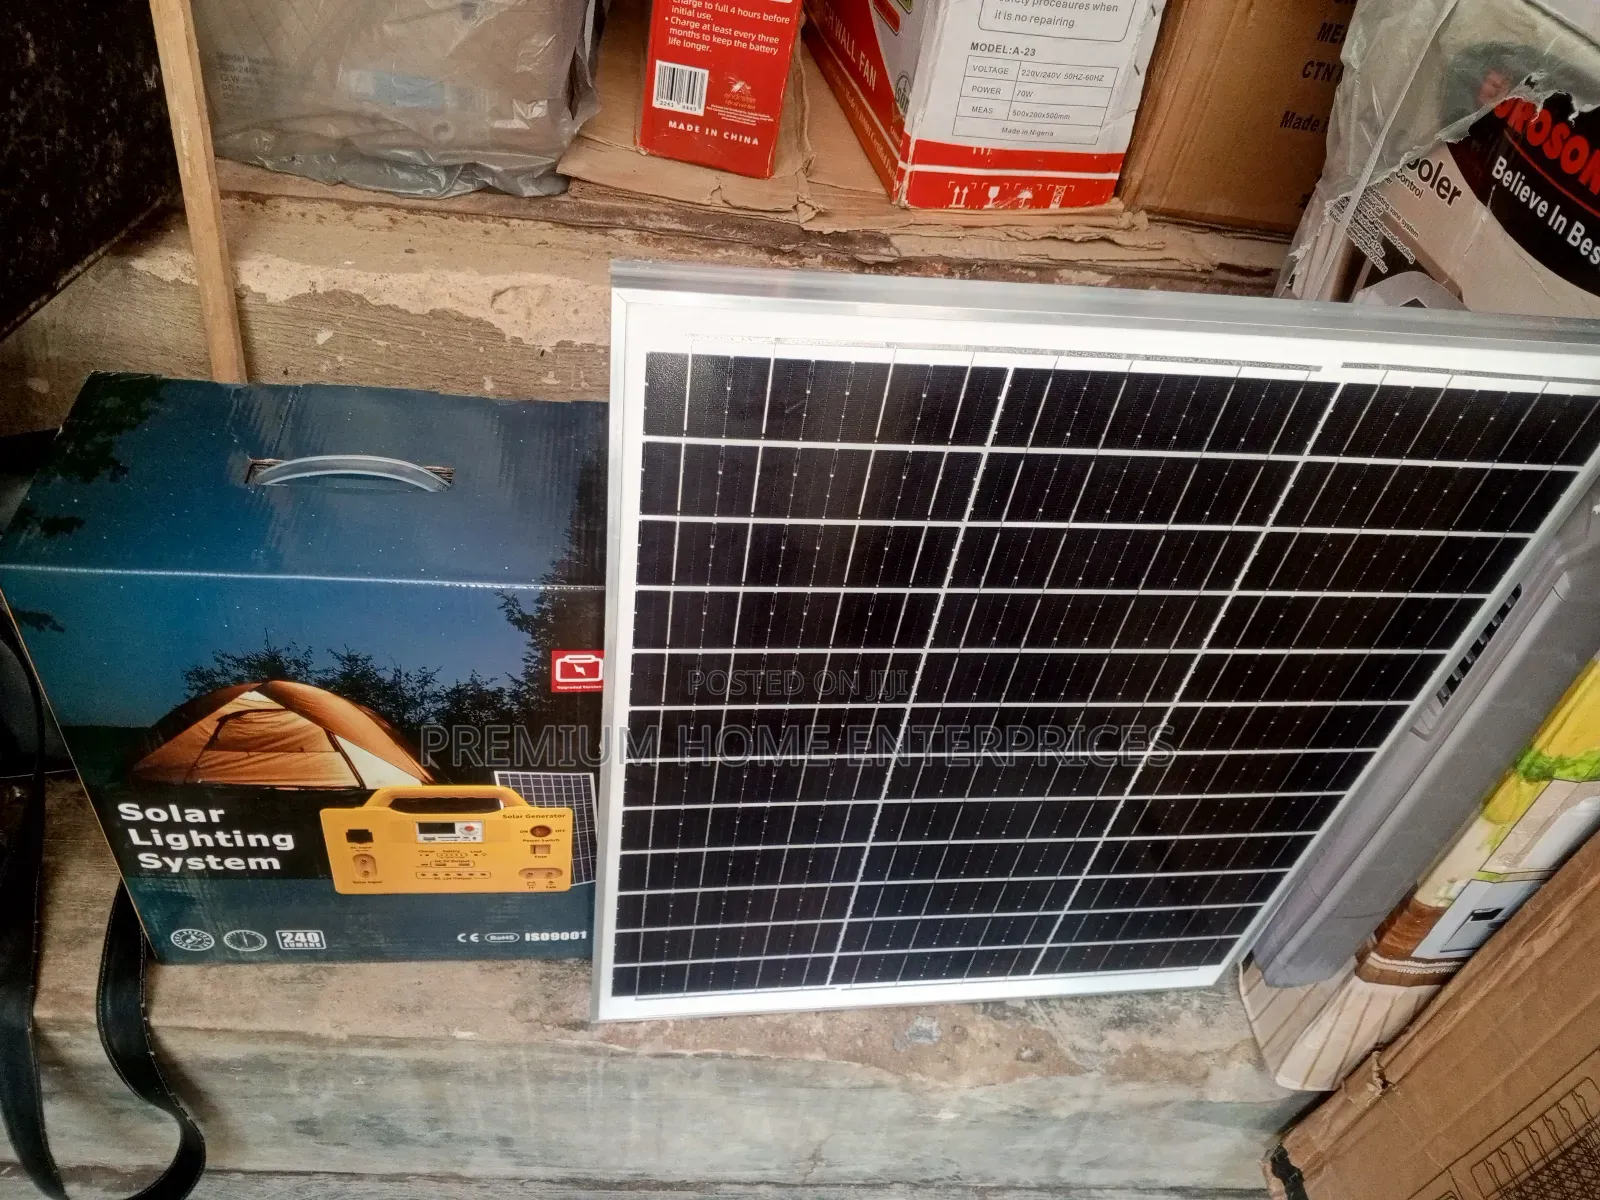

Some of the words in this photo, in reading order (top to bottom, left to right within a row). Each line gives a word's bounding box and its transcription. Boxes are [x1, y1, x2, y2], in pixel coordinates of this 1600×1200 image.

[671, 5, 695, 17] initial
[697, 12, 713, 21] use.
[705, 2, 713, 10] to
[715, 4, 729, 13] full
[738, 8, 761, 19] hours
[763, 12, 791, 24] before
[1092, 2, 1119, 12] when
[994, 9, 1002, 20] it
[1003, 11, 1012, 21] is
[1014, 14, 1028, 22] no
[1029, 16, 1075, 29] repairing
[670, 16, 700, 29] Charge
[702, 22, 710, 31] at
[712, 24, 733, 35] least
[734, 29, 756, 41] every
[757, 34, 780, 44] three
[668, 37, 681, 46] life
[683, 39, 712, 52] longer.
[669, 27, 700, 40] months
[702, 33, 711, 41] to
[712, 35, 733, 47] keep
[733, 39, 748, 49] the
[749, 42, 779, 55] battery
[970, 42, 1036, 57] MODEL:A-23
[835, 15, 856, 63] WALL
[859, 50, 877, 91] FAN
[972, 64, 1009, 75] VOLTAGE
[1021, 69, 1062, 79] 220V/240V
[1302, 60, 1336, 82] CTN
[971, 85, 1002, 95] POWER
[1016, 89, 1034, 98] 70W
[971, 105, 994, 114] MEAS
[1279, 110, 1320, 132] Made
[668, 120, 701, 133] MADE
[705, 128, 718, 137] IN
[723, 132, 760, 146] CHINA
[1001, 127, 1021, 136] Made
[1029, 130, 1055, 138] Nigeria
[1491, 155, 1549, 218] Believe
[1548, 205, 1567, 235] In
[1567, 220, 1600, 265] Bes
[117, 803, 225, 823] Solar
[127, 828, 295, 851] Lighting
[137, 852, 281, 873] System
[281, 932, 320, 943] 240
[524, 930, 587, 942] ISO9001
